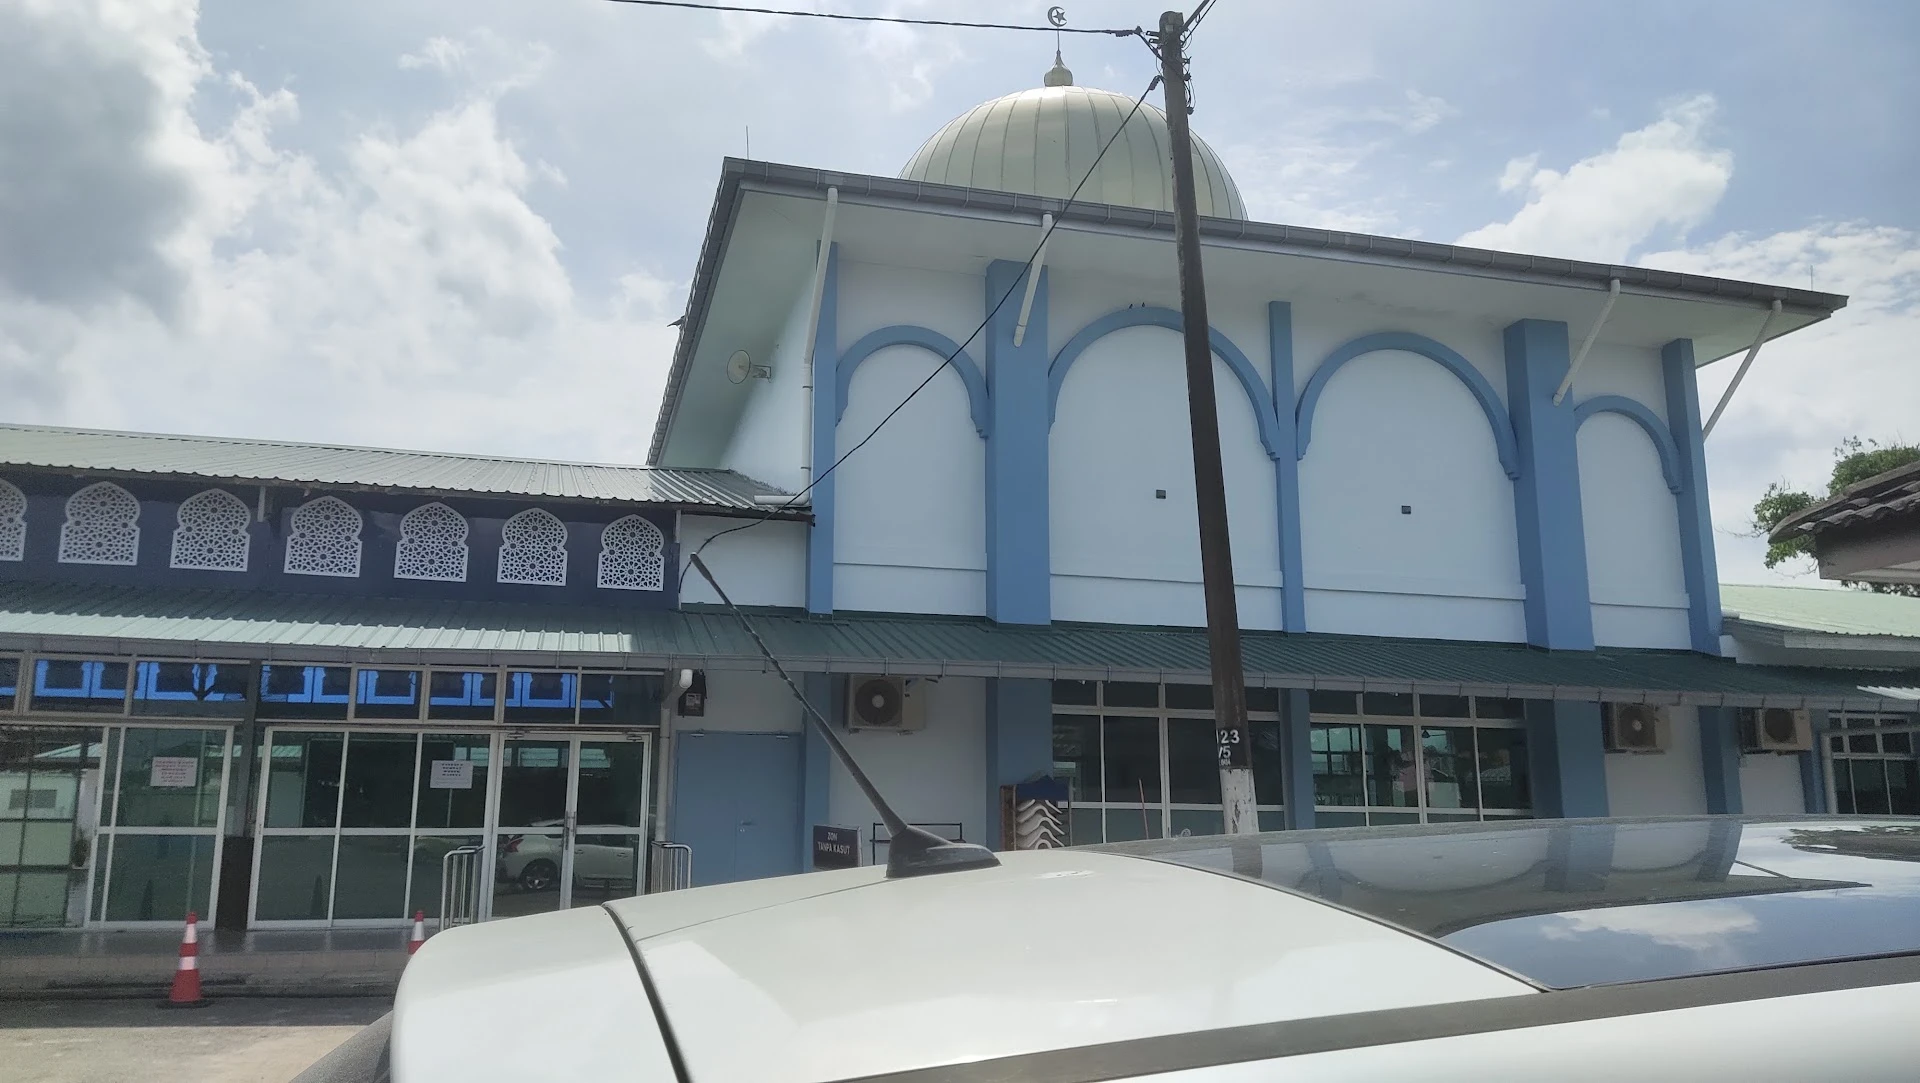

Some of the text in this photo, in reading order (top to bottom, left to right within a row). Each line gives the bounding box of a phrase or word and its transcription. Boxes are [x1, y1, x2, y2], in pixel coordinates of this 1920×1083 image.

[827, 831, 838, 841] ZON
[817, 841, 850, 855] TANPA KASUT
